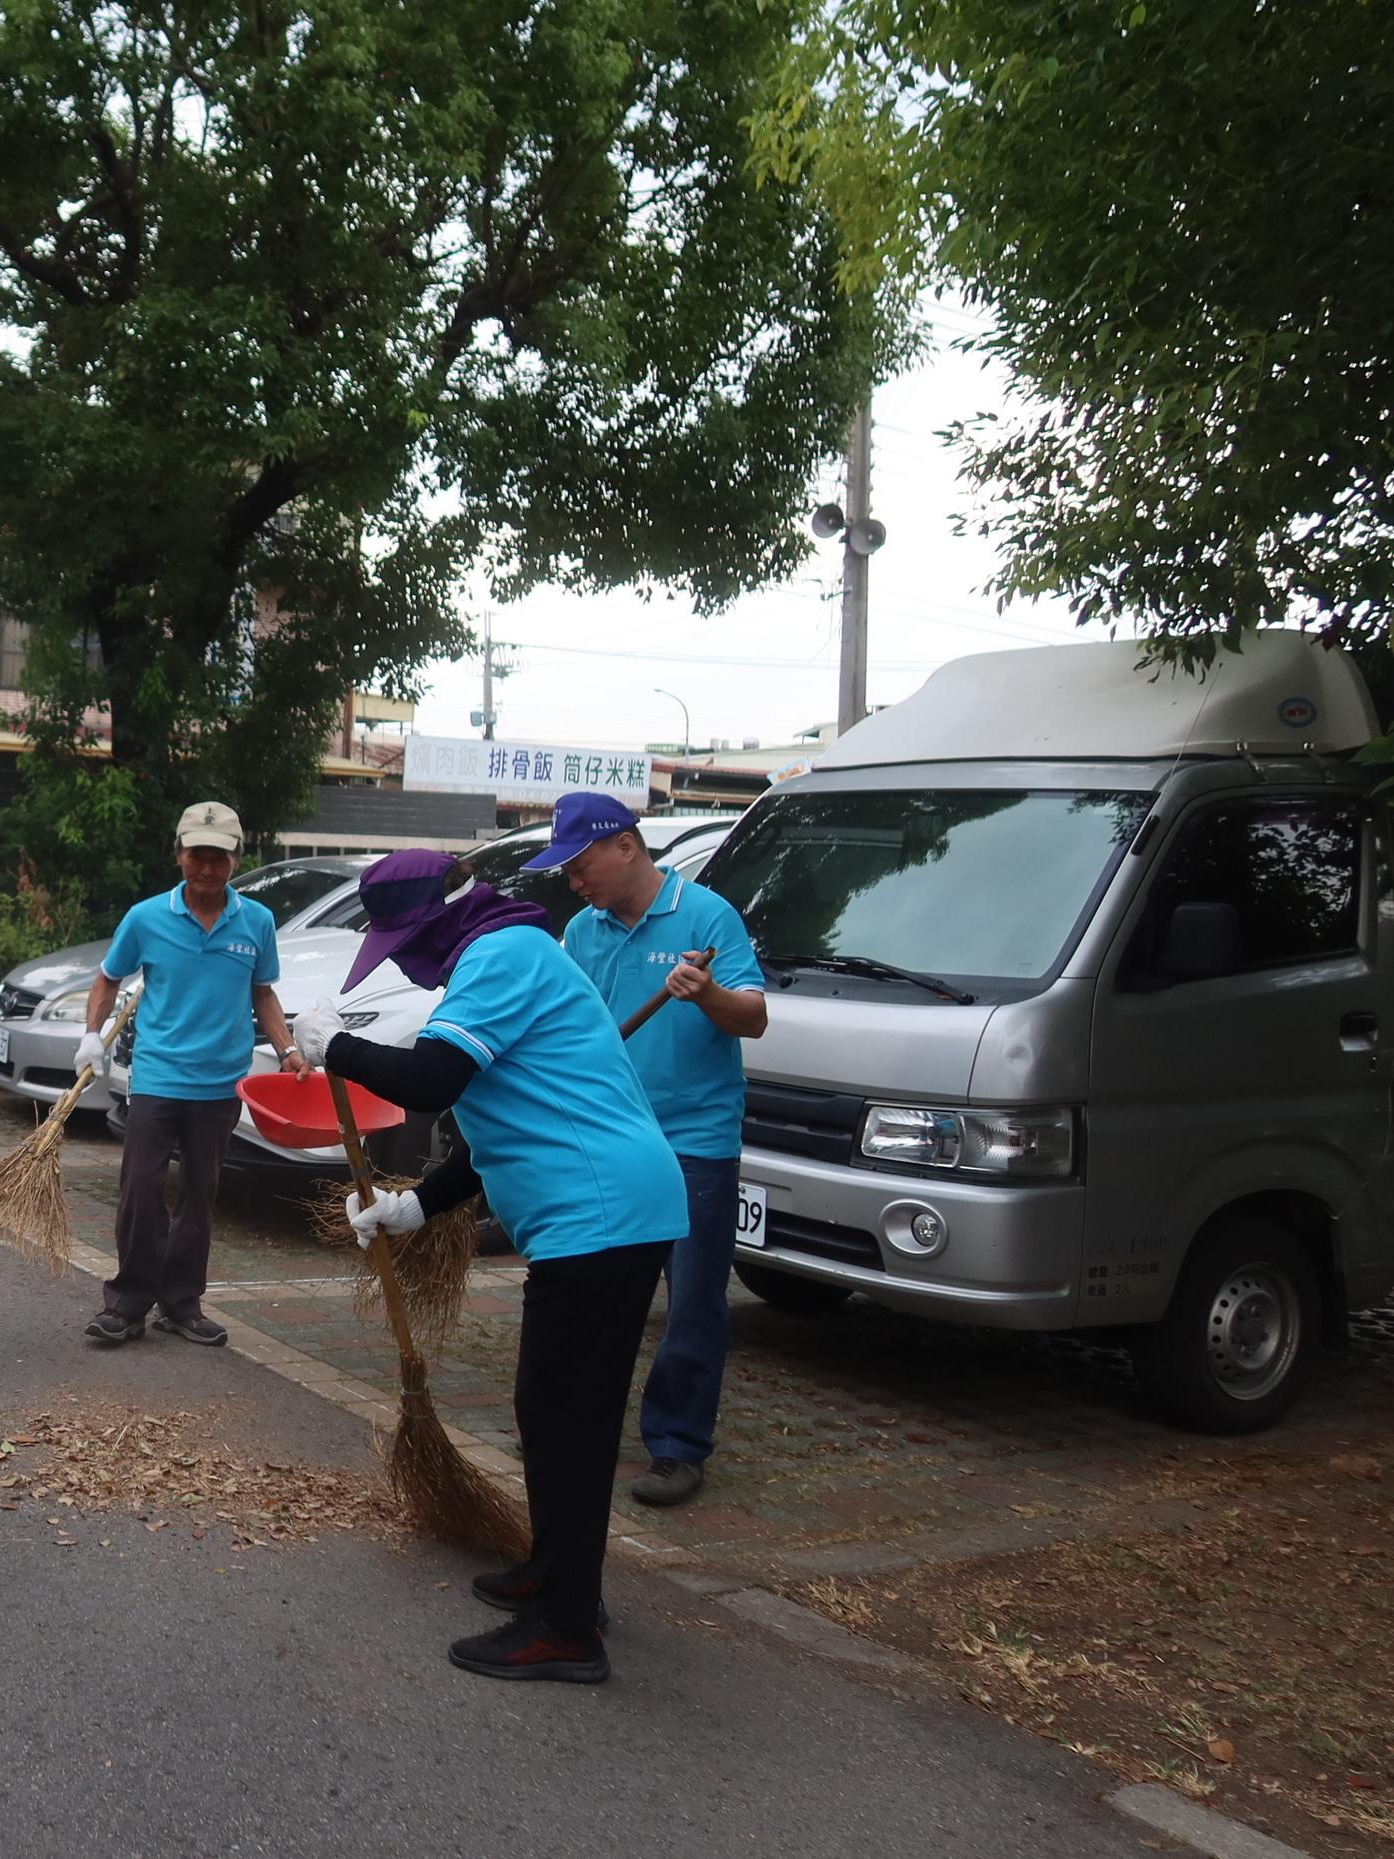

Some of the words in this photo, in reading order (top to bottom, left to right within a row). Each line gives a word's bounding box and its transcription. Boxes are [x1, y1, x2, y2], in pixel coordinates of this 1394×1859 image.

[488, 747, 554, 782] 排骨飯
[563, 753, 646, 788] 筒仔米糕
